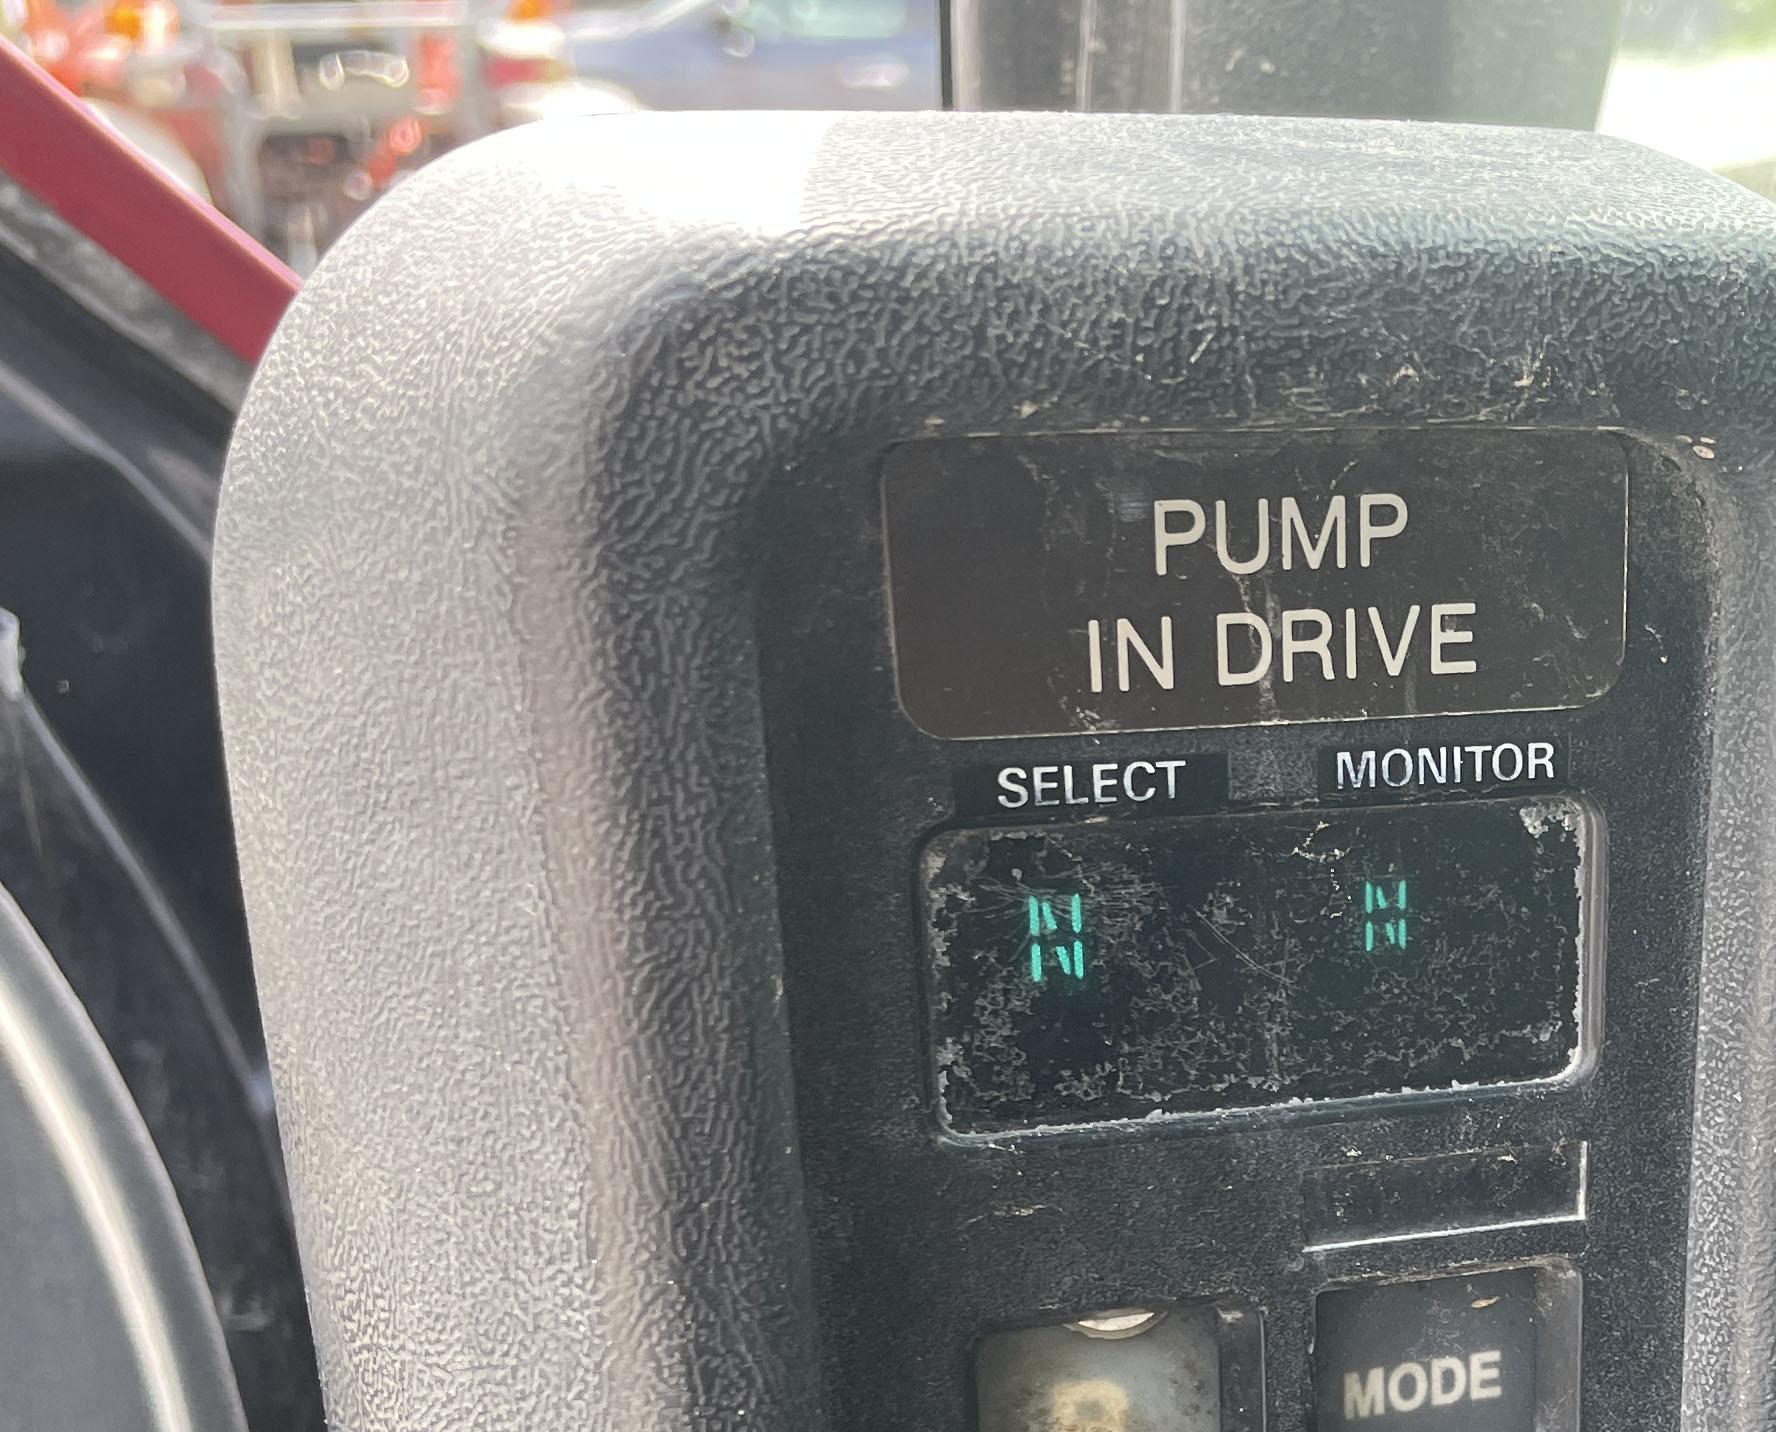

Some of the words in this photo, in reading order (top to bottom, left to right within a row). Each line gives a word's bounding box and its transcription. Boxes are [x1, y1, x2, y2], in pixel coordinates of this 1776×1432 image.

[1151, 493, 1410, 576] PUMP
[1088, 616, 1176, 693] IN
[1216, 602, 1478, 688] DRIVE
[996, 760, 1187, 808] SELECT
[1335, 741, 1556, 791] MONITOR
[1028, 892, 1085, 983] N
[1364, 880, 1408, 953] N
[1342, 1350, 1503, 1420] MODE
